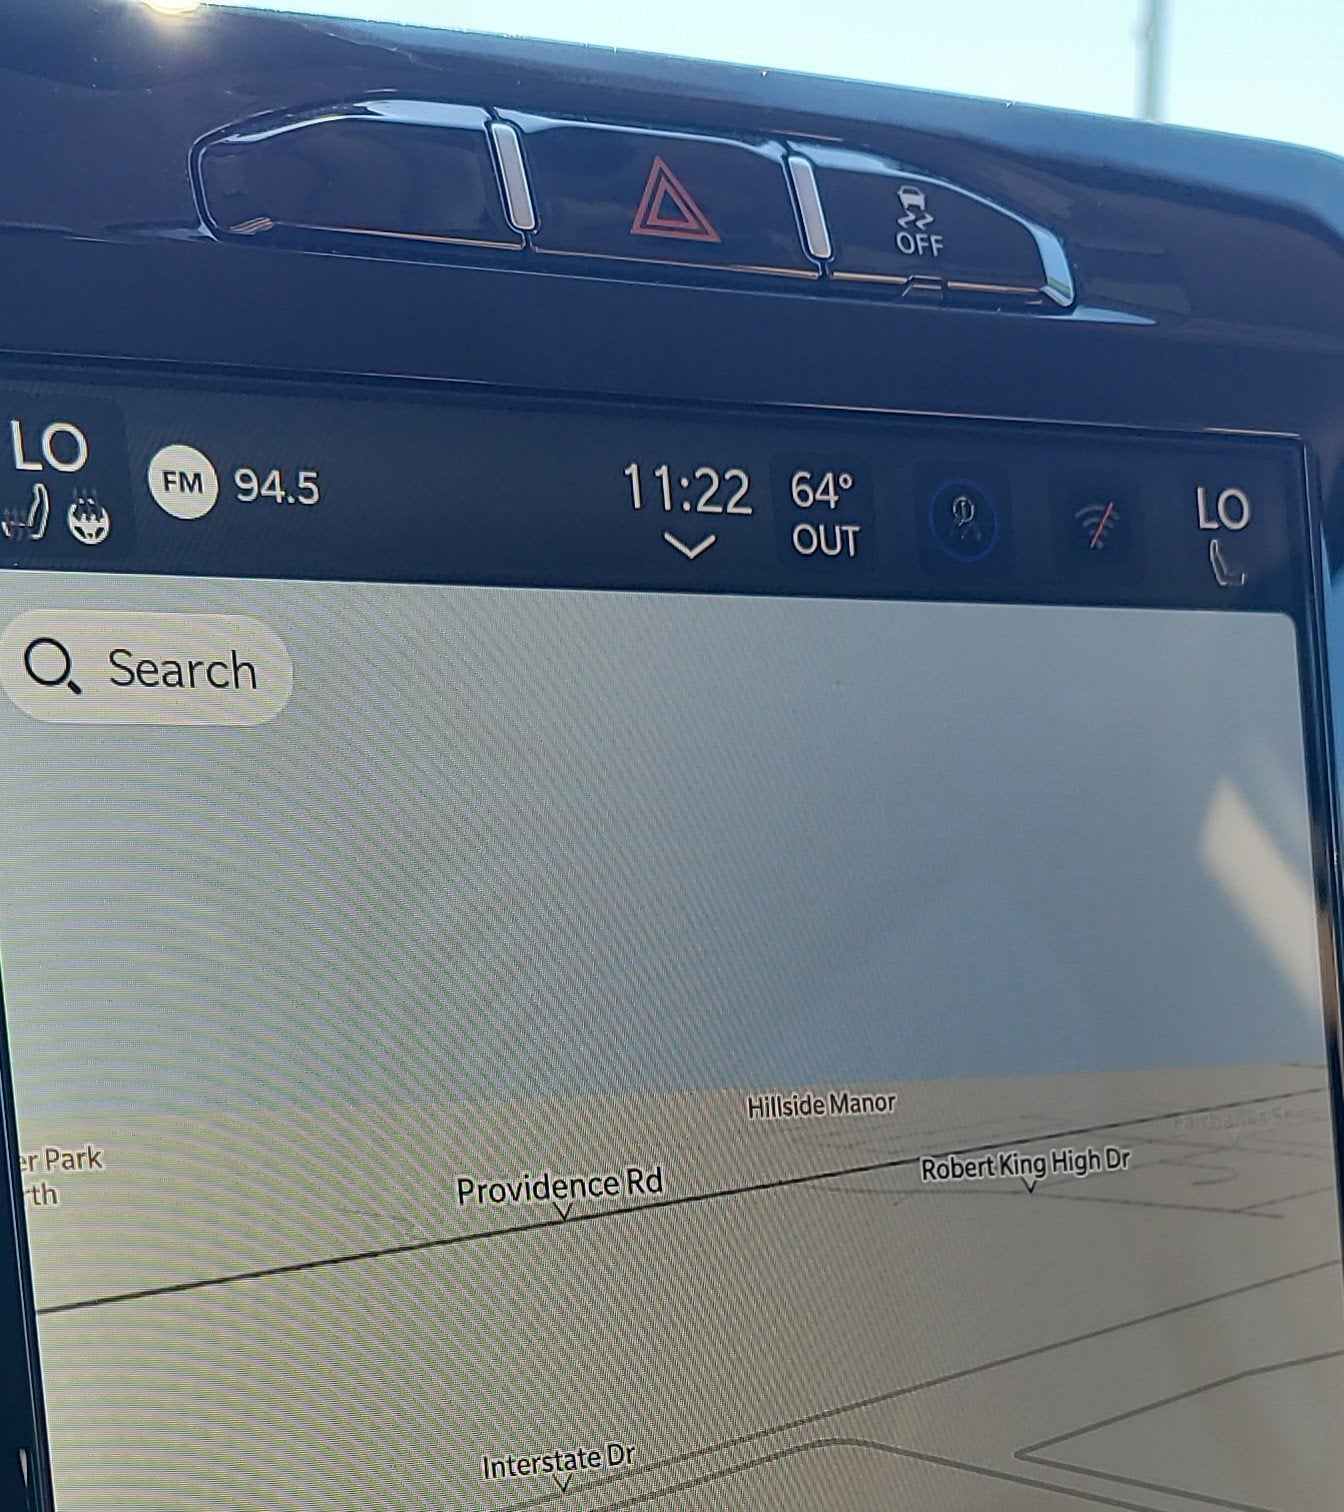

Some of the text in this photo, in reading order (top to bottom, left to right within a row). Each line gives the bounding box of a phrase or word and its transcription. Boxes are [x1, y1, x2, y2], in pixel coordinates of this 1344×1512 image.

[896, 231, 944, 257] OFF
[9, 418, 89, 473] LO
[161, 467, 321, 505] FM 94.5
[623, 462, 754, 515] 11:22
[1197, 486, 1252, 531] LO
[791, 522, 862, 558] OUT
[108, 647, 259, 692] Search
[747, 1092, 897, 1119] Hillside Manor
[44, 1145, 103, 1171] Park
[921, 1147, 1131, 1181] Robert King High Dr
[456, 1165, 664, 1206] Providence Rd
[483, 1443, 636, 1480] Interstate Dr
